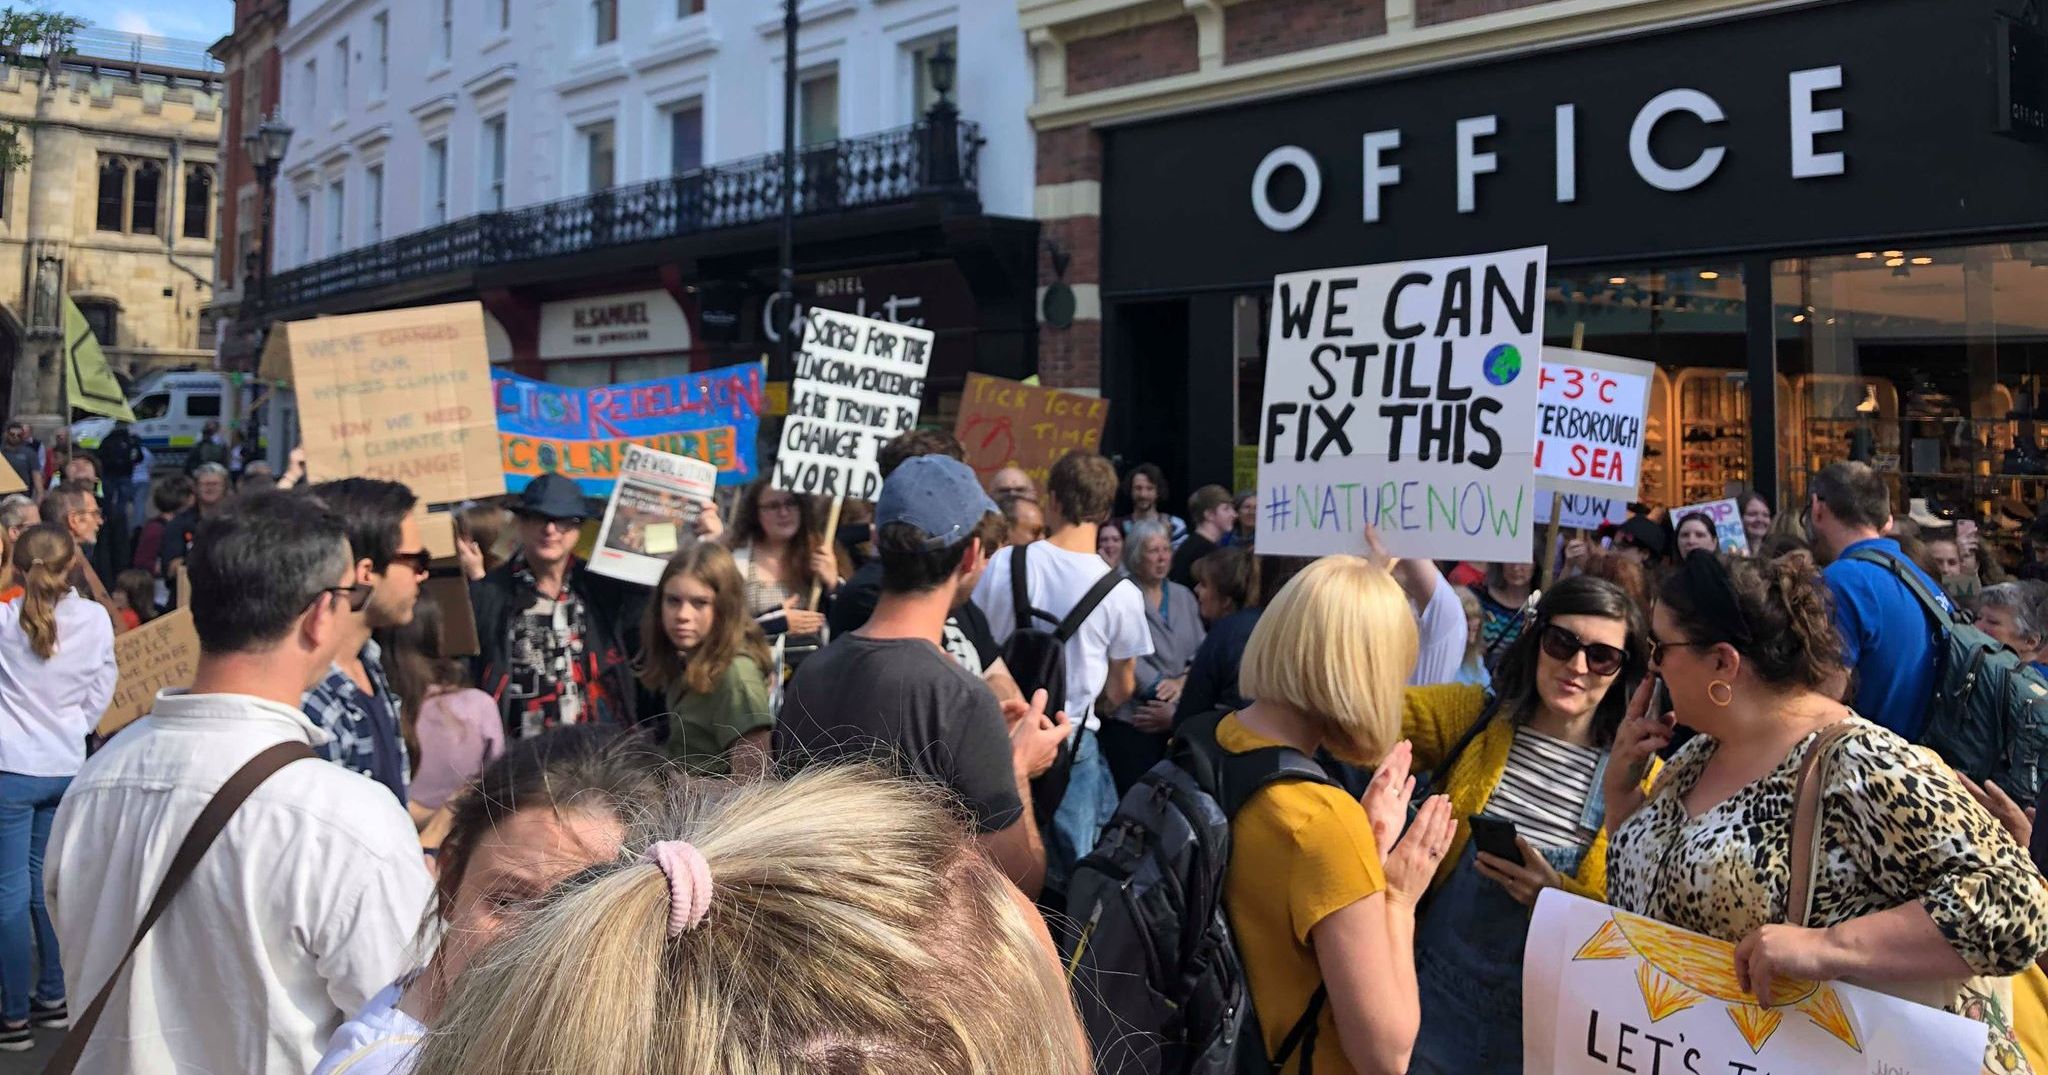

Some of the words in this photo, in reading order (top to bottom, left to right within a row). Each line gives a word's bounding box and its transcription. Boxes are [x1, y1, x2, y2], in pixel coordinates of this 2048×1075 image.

[1251, 65, 1845, 232] OFFICE
[815, 276, 865, 297] HOTEL
[1279, 276, 1359, 340] WE
[1382, 260, 1538, 341] CAN
[864, 325, 898, 360] FOR
[902, 335, 929, 365] THE
[1307, 340, 1473, 402] STILL
[588, 368, 764, 441] REBELLION
[896, 405, 914, 433] TO
[1538, 403, 1640, 449] ERBOROUGH
[787, 420, 863, 461] CHANGE
[1263, 401, 1355, 465] FIX
[1378, 396, 1504, 471] THIS
[776, 456, 877, 502] WORLD
[1567, 442, 1624, 483] SEA
